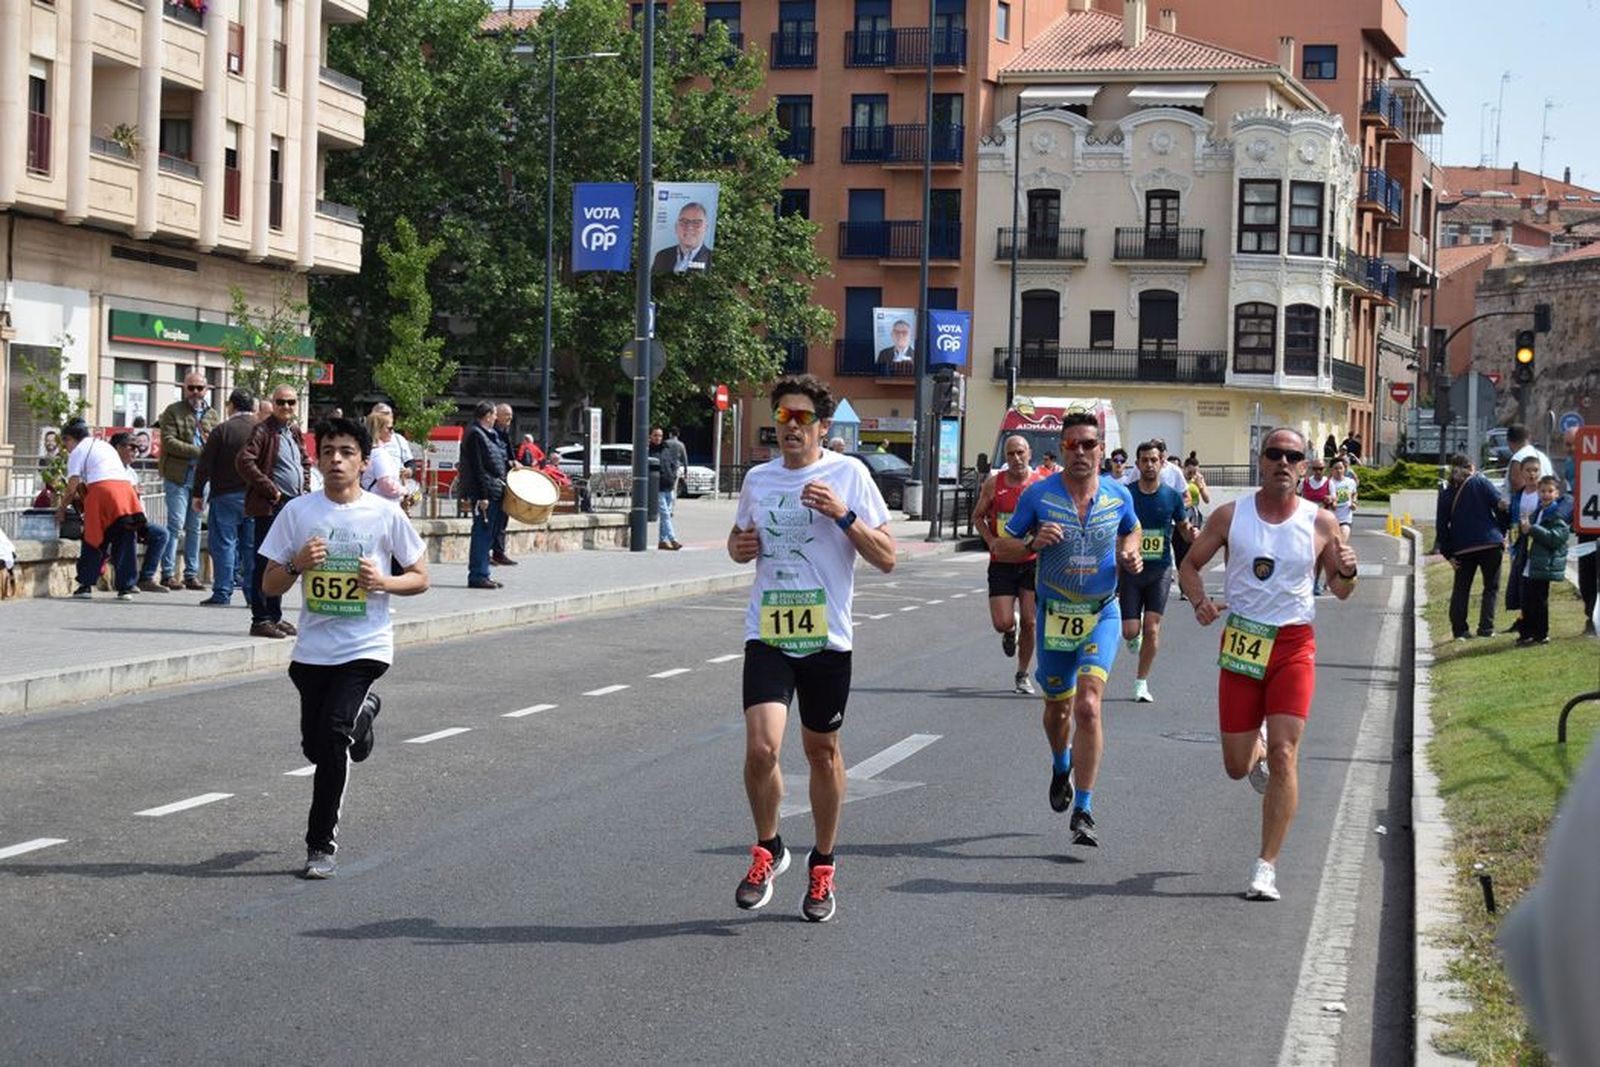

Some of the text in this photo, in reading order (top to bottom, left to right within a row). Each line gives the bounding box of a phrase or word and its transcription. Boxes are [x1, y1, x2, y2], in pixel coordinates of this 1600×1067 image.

[584, 207, 620, 219] VOTA
[937, 324, 962, 333] VOTA
[1142, 537, 1160, 551] 09
[311, 576, 359, 600] 652
[769, 609, 815, 635] 114
[1058, 615, 1084, 637] 78
[1230, 631, 1262, 660] 154
